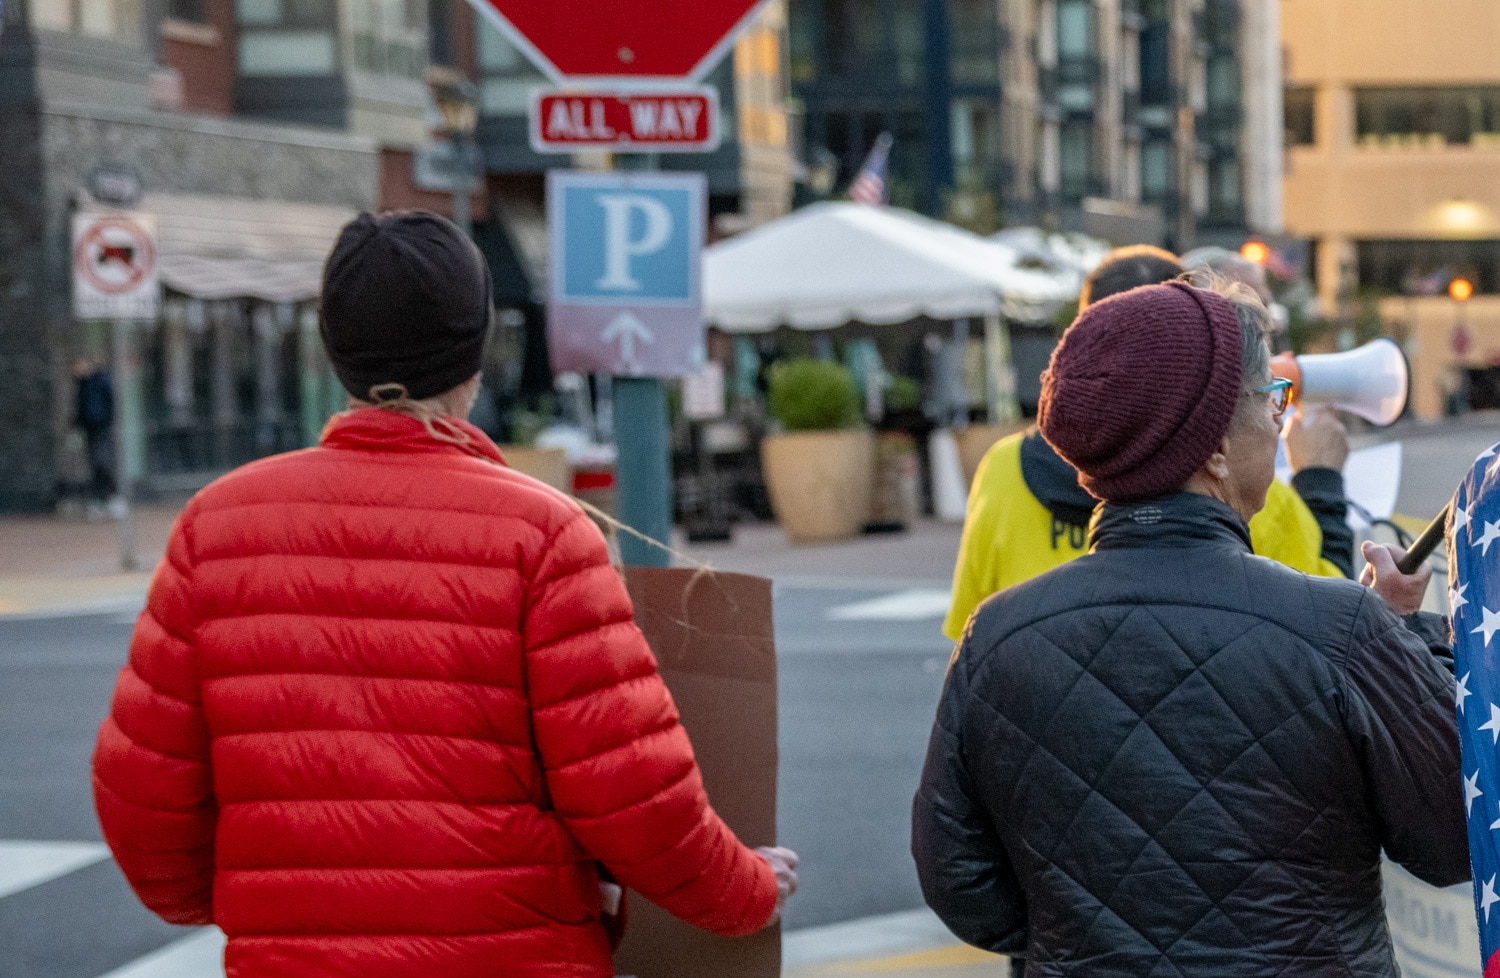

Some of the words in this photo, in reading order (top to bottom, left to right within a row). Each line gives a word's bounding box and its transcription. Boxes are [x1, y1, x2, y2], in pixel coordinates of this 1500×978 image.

[547, 100, 615, 140] ALL
[628, 100, 704, 140] WAY
[595, 192, 674, 293] P
